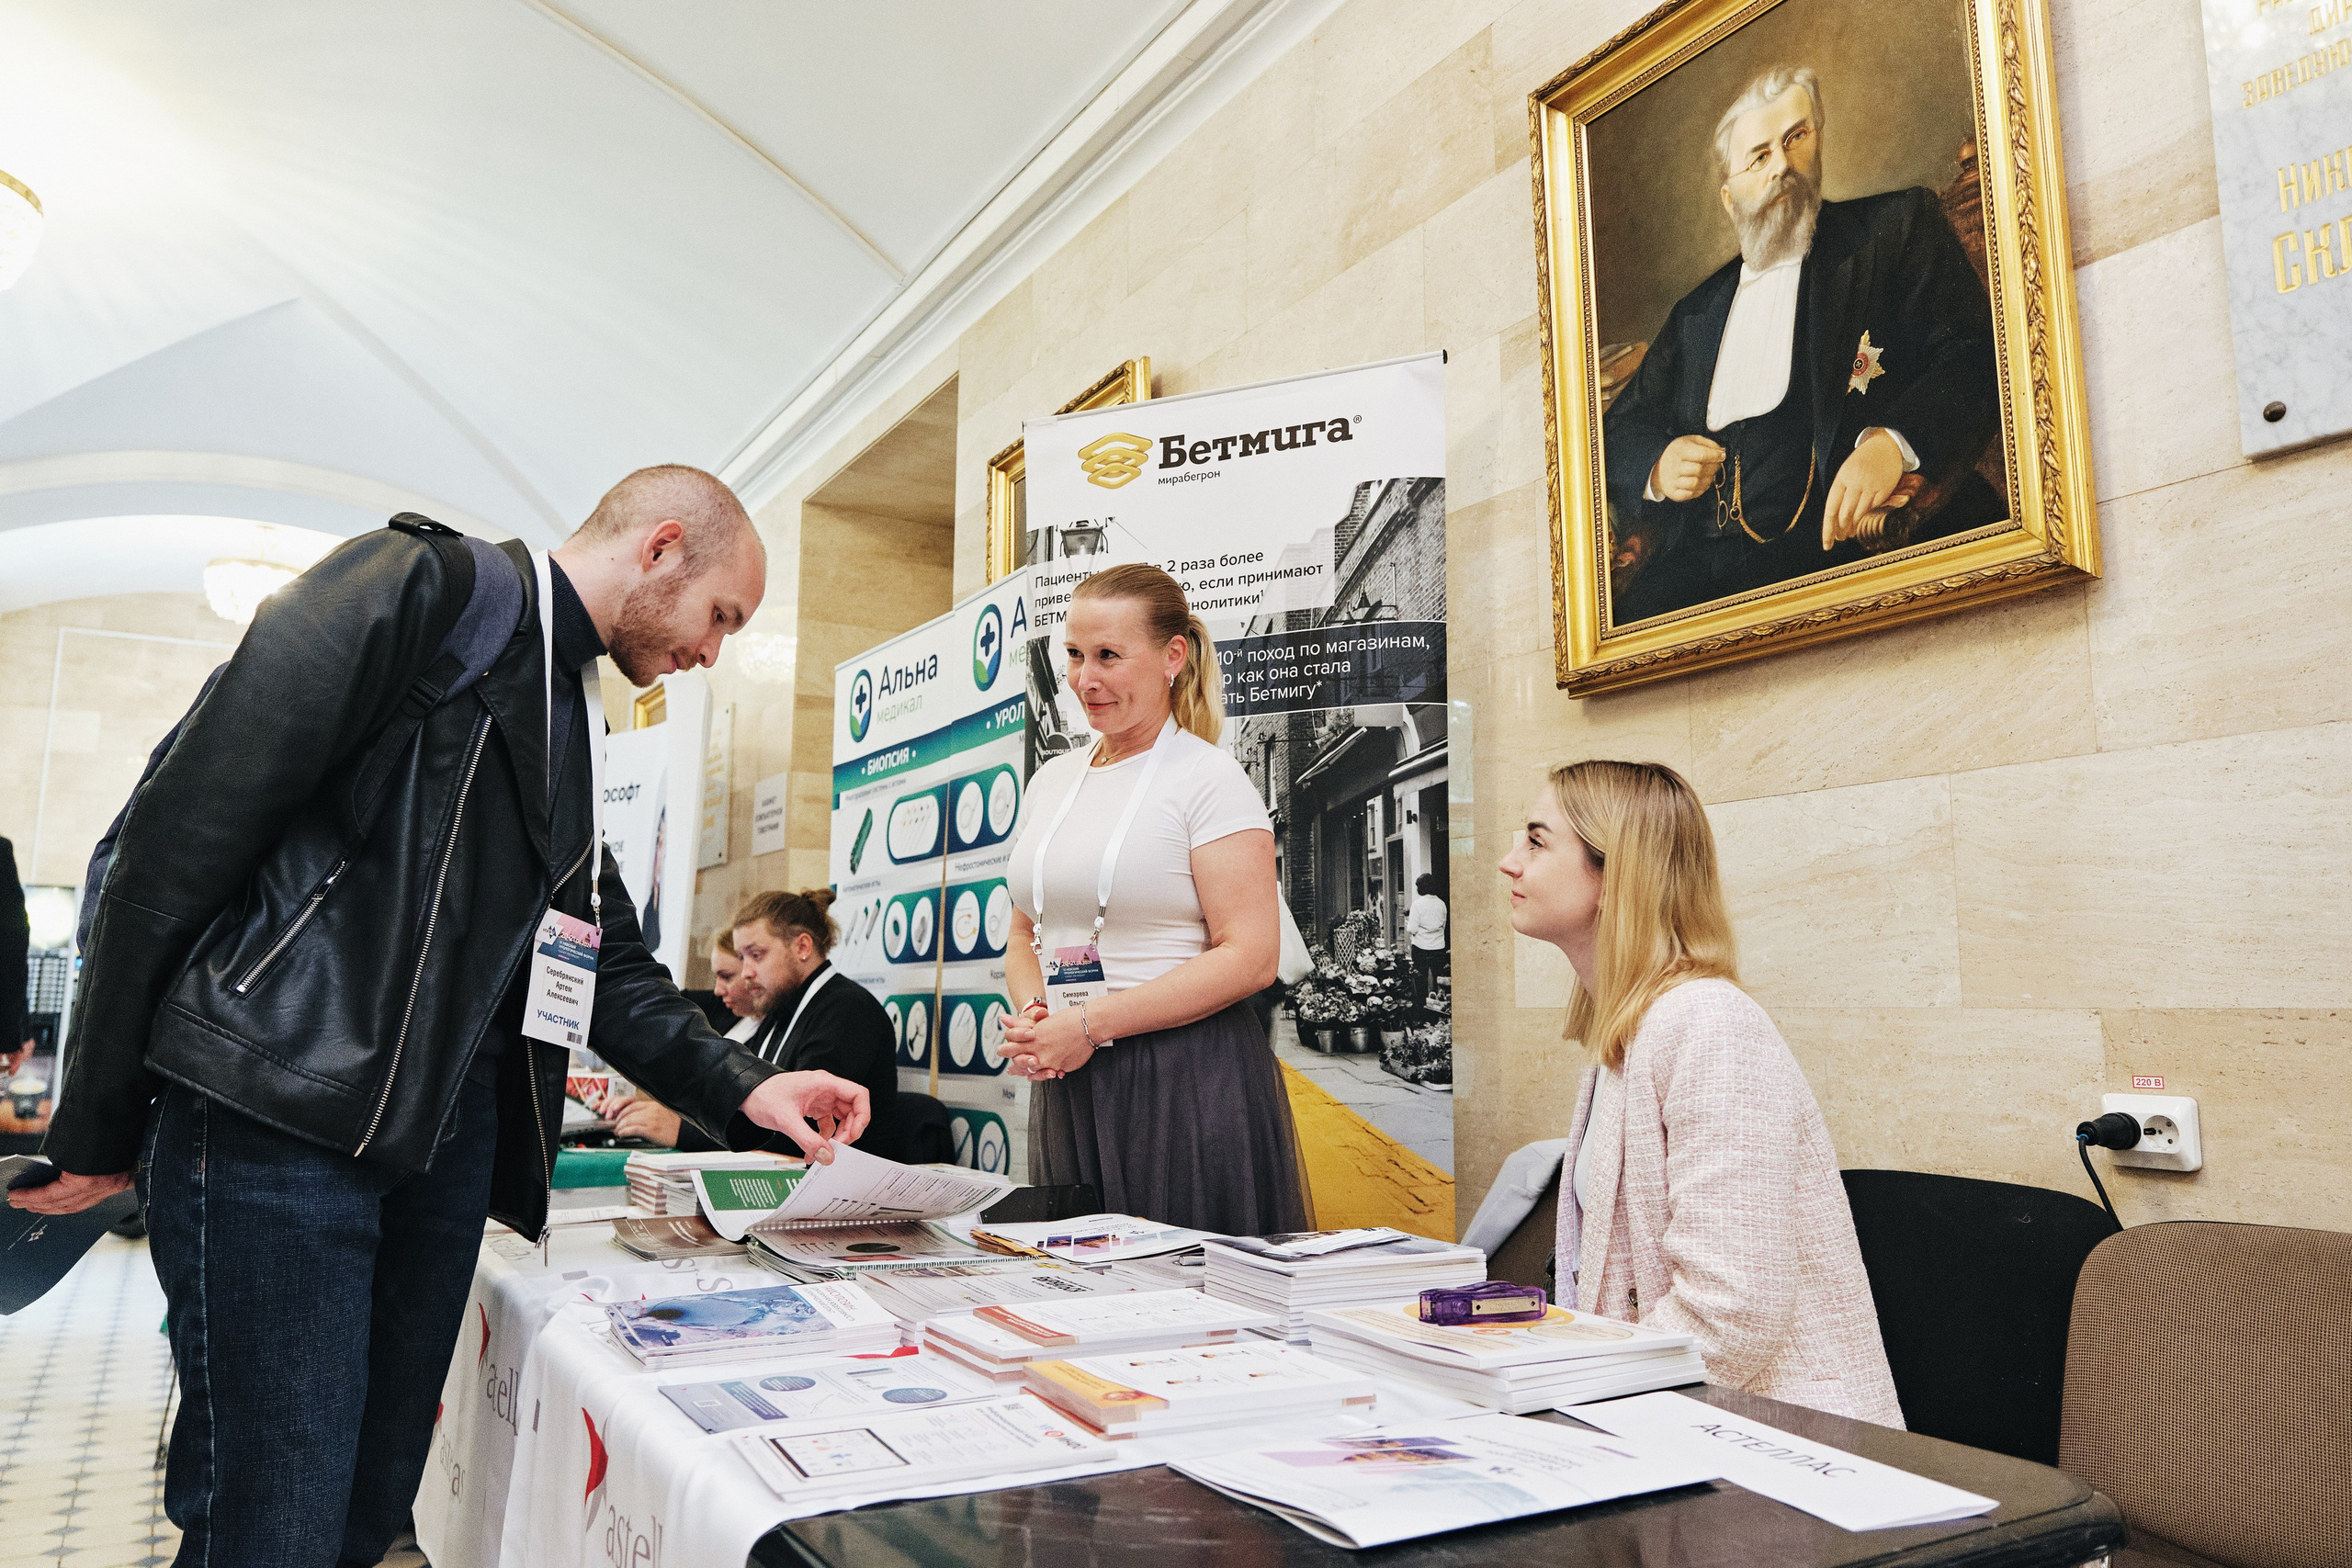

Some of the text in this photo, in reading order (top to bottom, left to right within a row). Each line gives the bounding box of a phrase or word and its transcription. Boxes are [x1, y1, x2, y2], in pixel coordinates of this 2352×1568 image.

[1158, 470, 1221, 486] мирабегрон
[1167, 559, 1176, 572] 2
[1181, 558, 1216, 574] раза
[1219, 552, 1264, 567] более
[1199, 577, 1234, 590] если
[1238, 564, 1323, 587] принимают
[1248, 646, 1295, 663] поход
[1300, 643, 1321, 657] по
[1326, 635, 1430, 655] магазинам,
[878, 654, 938, 700] Альна
[1237, 669, 1265, 683] как
[1269, 665, 1298, 680] она
[1303, 660, 1351, 675] стала
[876, 694, 922, 725] медикал
[995, 701, 1025, 729] УРОЛ
[867, 747, 910, 776] БИОПСИЯ
[546, 965, 584, 986] Серебрянский
[555, 980, 572, 993] Артем
[546, 988, 579, 1007] Алексеевич
[537, 1009, 580, 1031] УЧАСТНИК
[2135, 1077, 2152, 1087] 220
[1690, 1425, 1857, 1477] АСТЕЛЛАС
